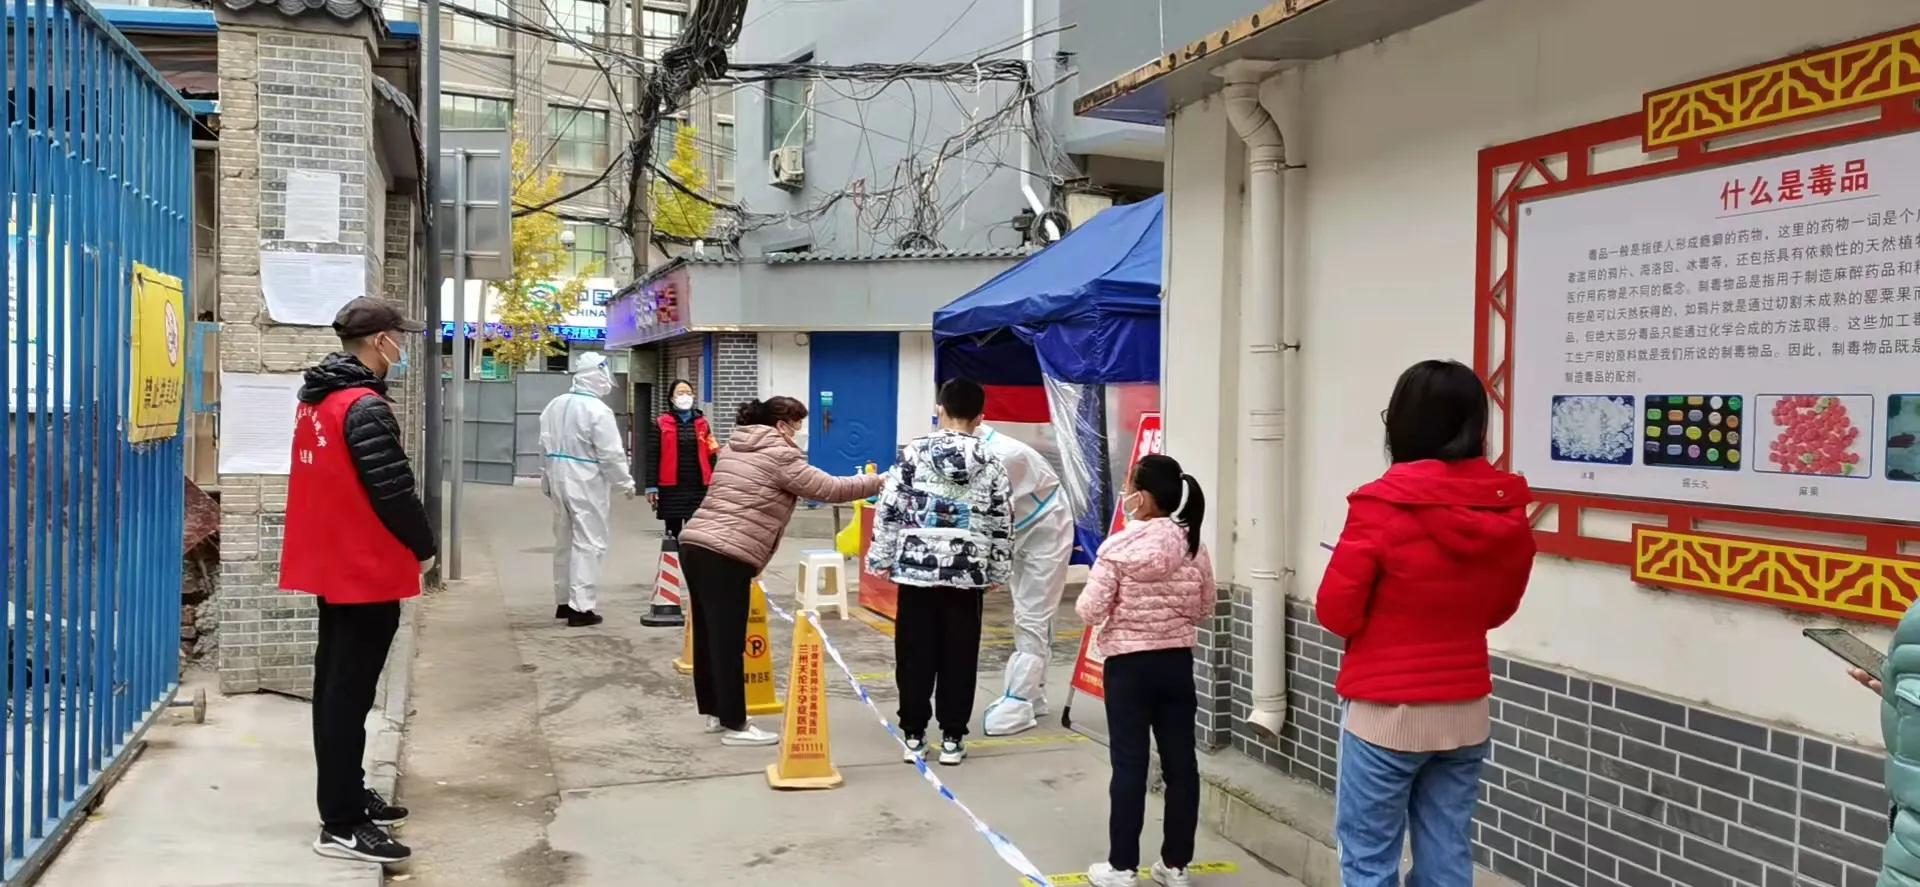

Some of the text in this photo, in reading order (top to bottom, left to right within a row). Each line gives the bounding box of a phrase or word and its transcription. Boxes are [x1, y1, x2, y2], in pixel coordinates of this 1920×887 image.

[1720, 159, 1869, 210] 什么是毒品
